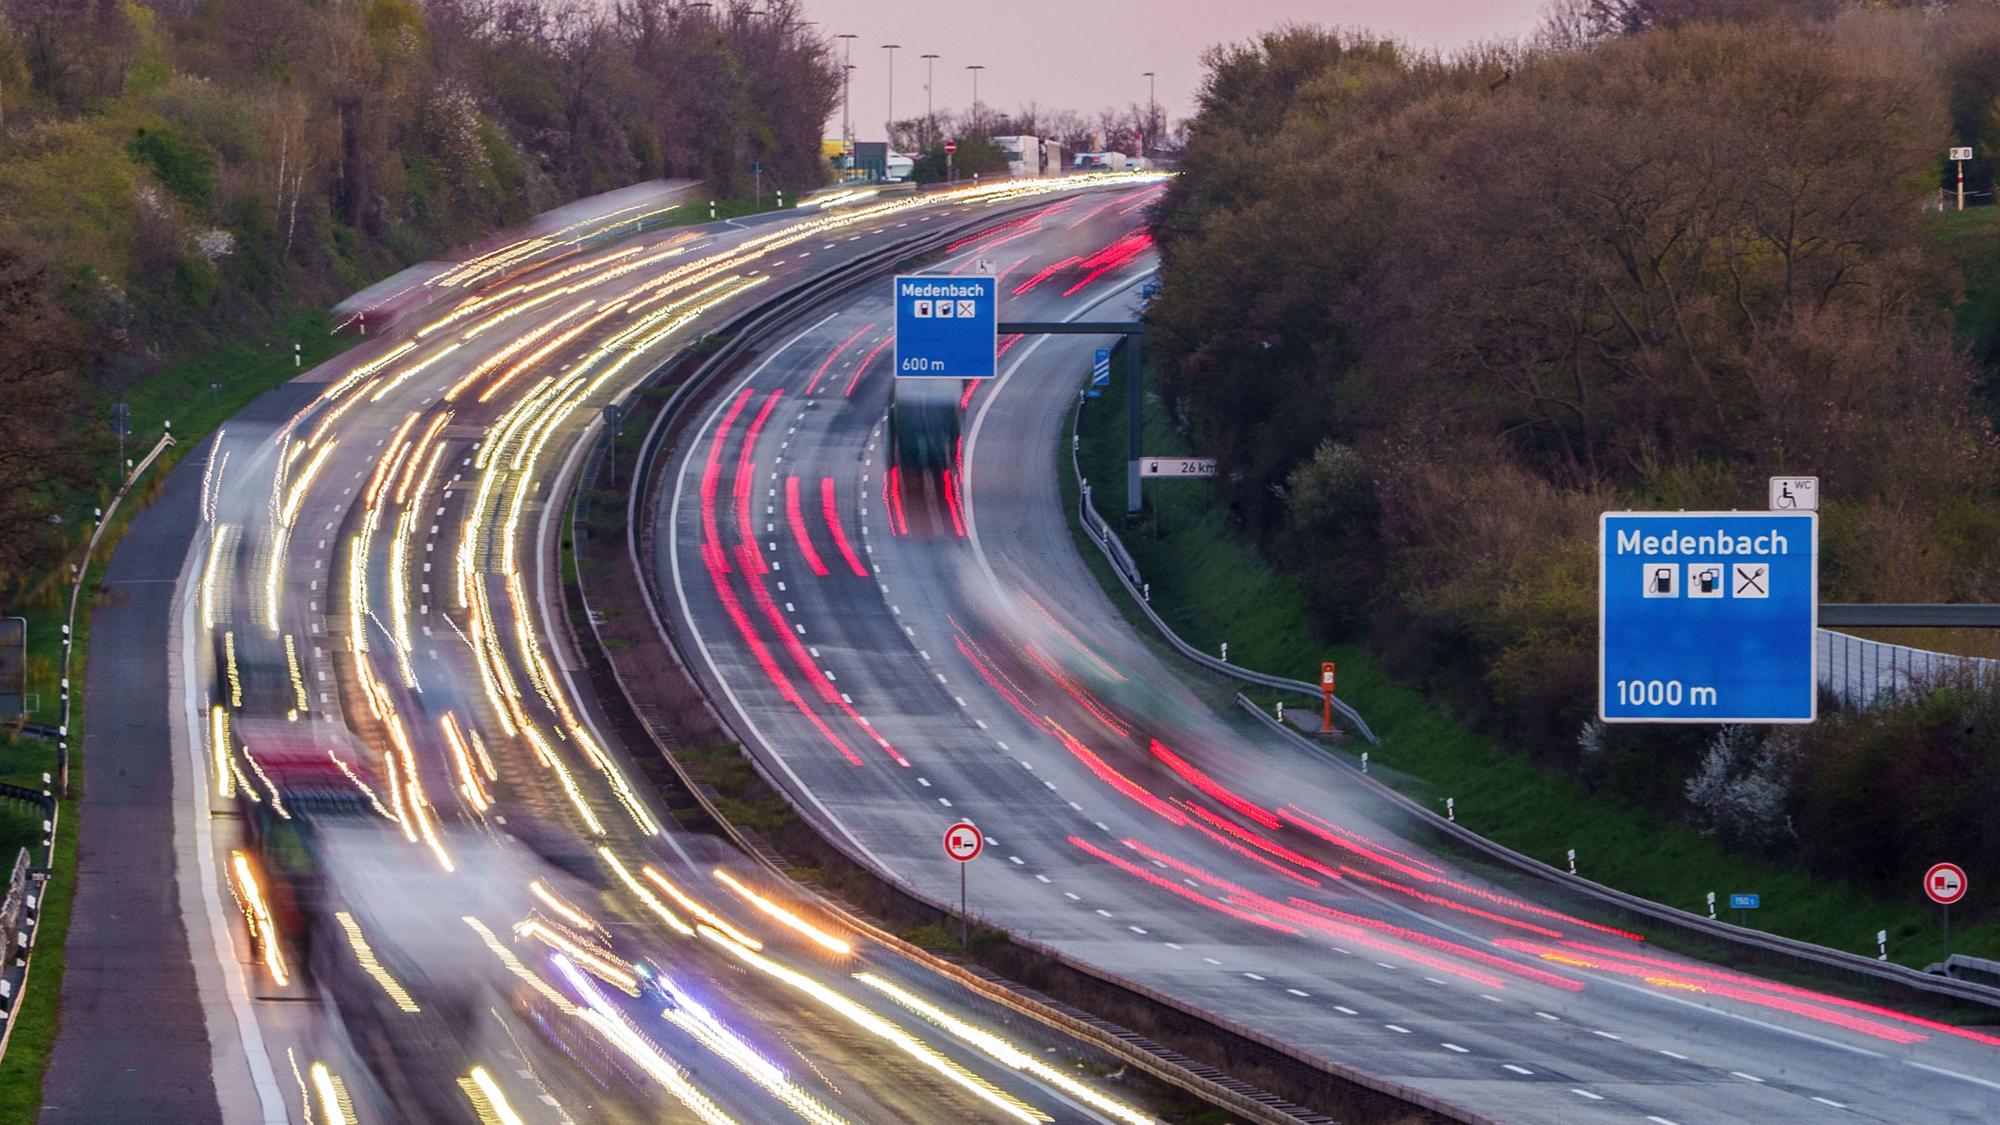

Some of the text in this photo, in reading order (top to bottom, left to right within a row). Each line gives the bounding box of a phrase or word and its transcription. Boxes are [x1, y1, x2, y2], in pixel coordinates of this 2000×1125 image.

[902, 283, 984, 297] Medenbach
[902, 357, 945, 371] 600 m
[1181, 462, 1196, 473] 26
[1794, 480, 1812, 490] WC
[1617, 529, 1788, 555] Medenbach
[1617, 680, 1717, 706] 1000 m
